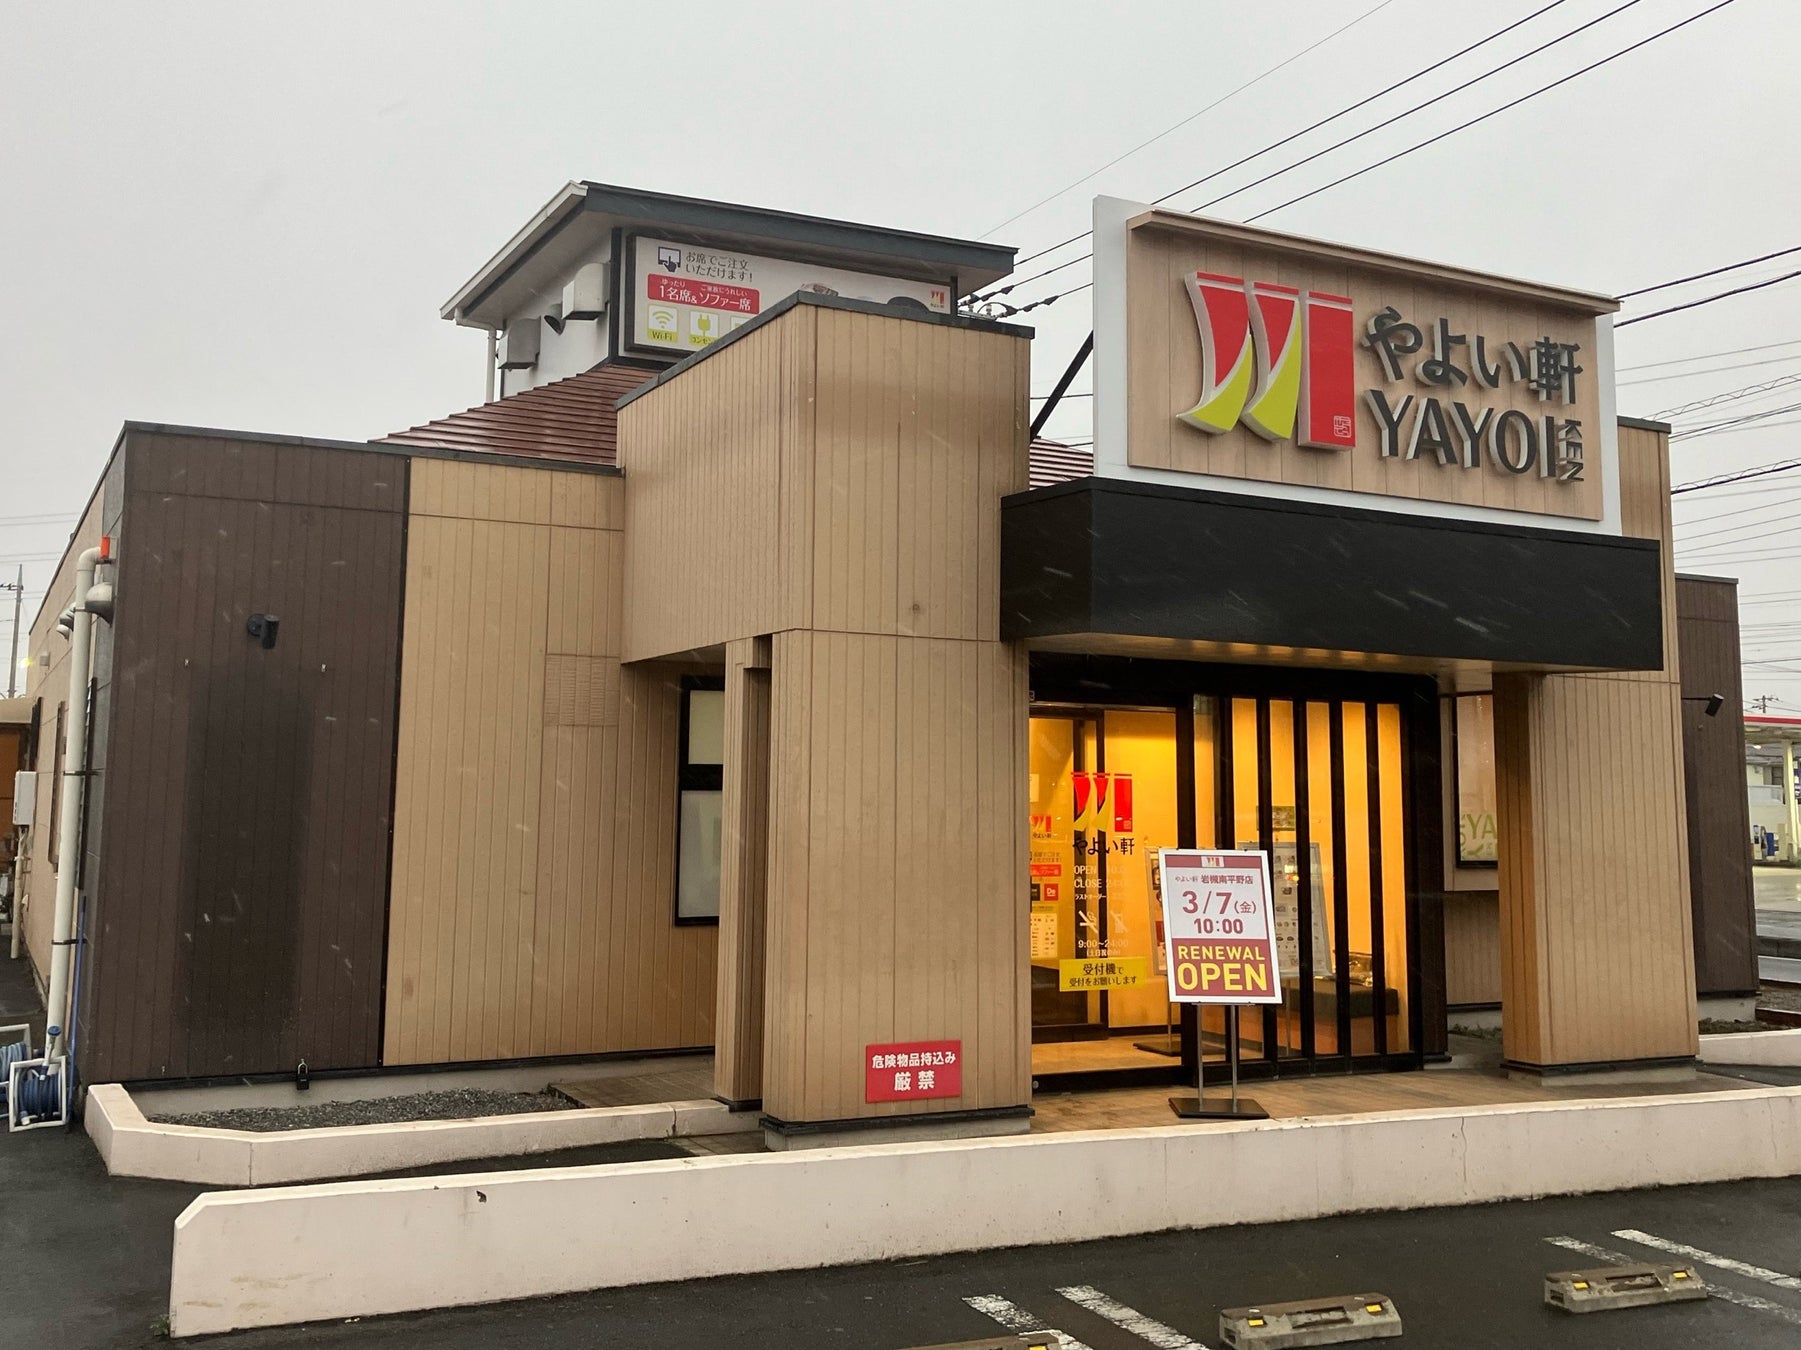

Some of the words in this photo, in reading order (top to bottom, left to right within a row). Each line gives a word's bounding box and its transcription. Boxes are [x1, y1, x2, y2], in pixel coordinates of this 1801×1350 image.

[686, 252, 748, 271] お席でご注文
[686, 264, 753, 282] いただけます!
[661, 278, 686, 287] ゆったり
[1364, 306, 1583, 404] やよい軒
[1365, 389, 1556, 478] YAYOI
[1560, 418, 1584, 481] KEN
[1072, 837, 1135, 856] やよい軒
[1074, 878, 1102, 889] CLOSE
[1201, 874, 1254, 885] 岩槻南平野店
[1194, 918, 1244, 935] 10:00
[1178, 945, 1265, 961] RENEWAL
[1083, 962, 1125, 976] 受付機で
[1177, 962, 1268, 991] OPEN
[1069, 976, 1137, 987] 受付をお願いします
[872, 1051, 956, 1069] 危険物品持込み
[894, 1070, 935, 1092] 厳禁
